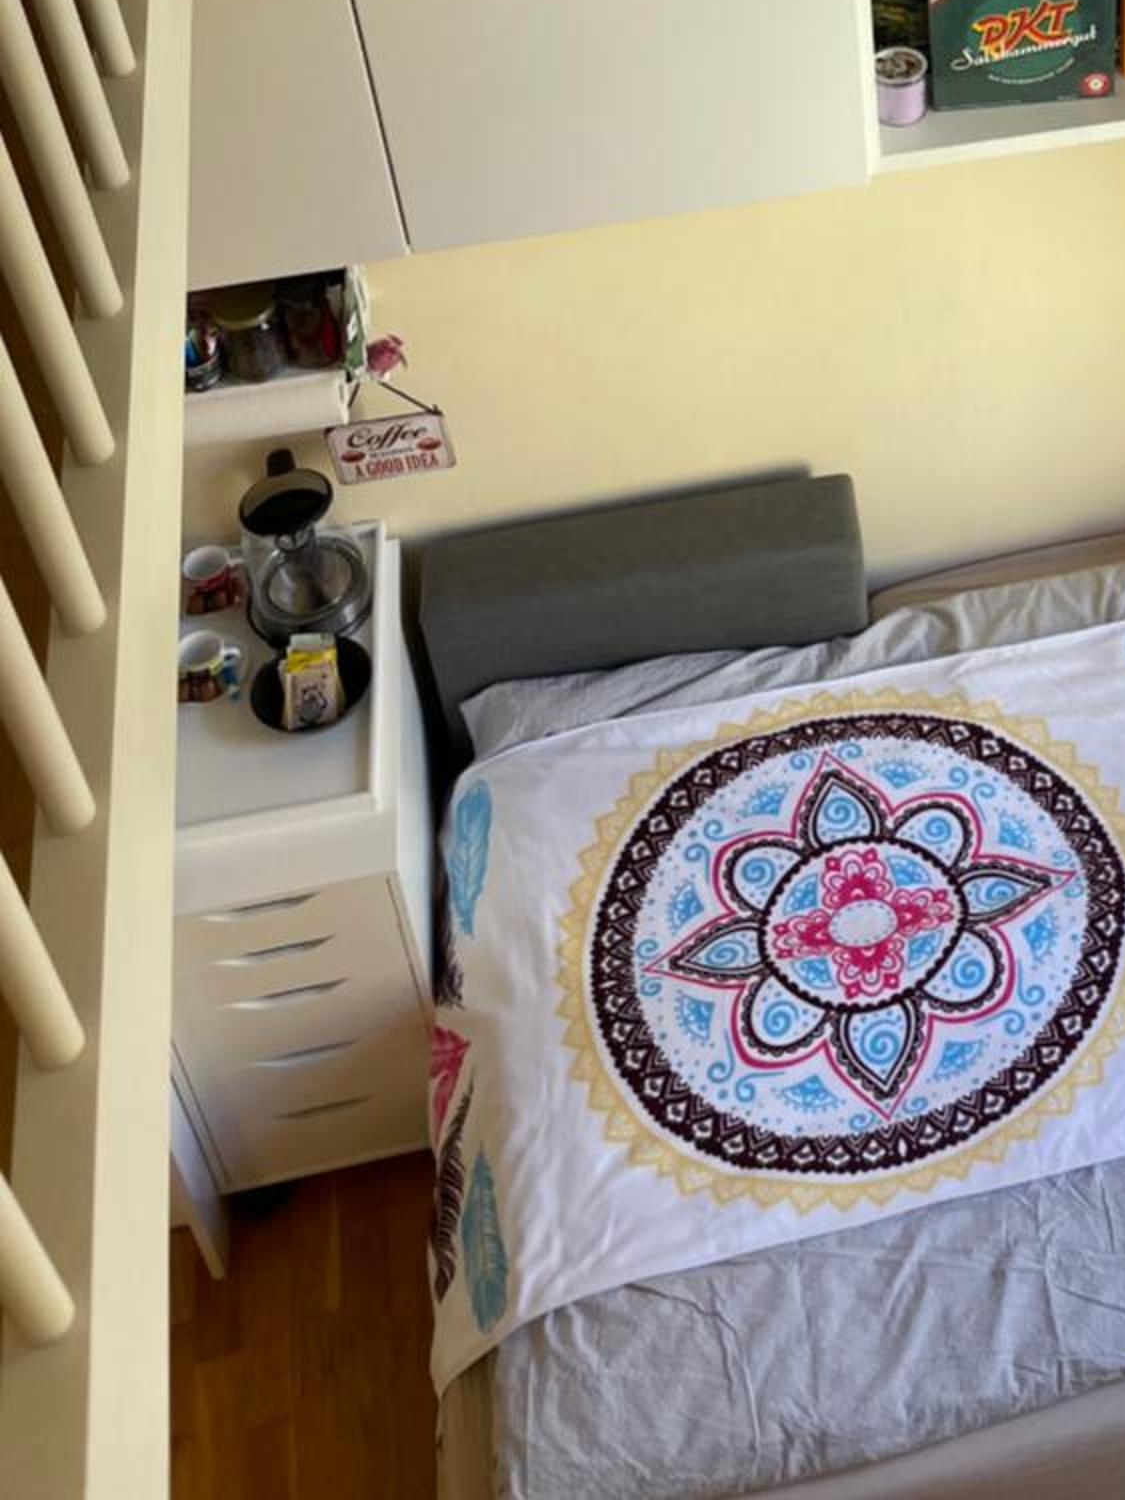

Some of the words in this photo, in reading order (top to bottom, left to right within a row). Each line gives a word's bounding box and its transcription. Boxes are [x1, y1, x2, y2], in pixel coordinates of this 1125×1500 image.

[347, 422, 428, 449] Coffee
[354, 464, 366, 478] A
[366, 458, 404, 476] GOOD
[406, 453, 439, 471] IDEA
